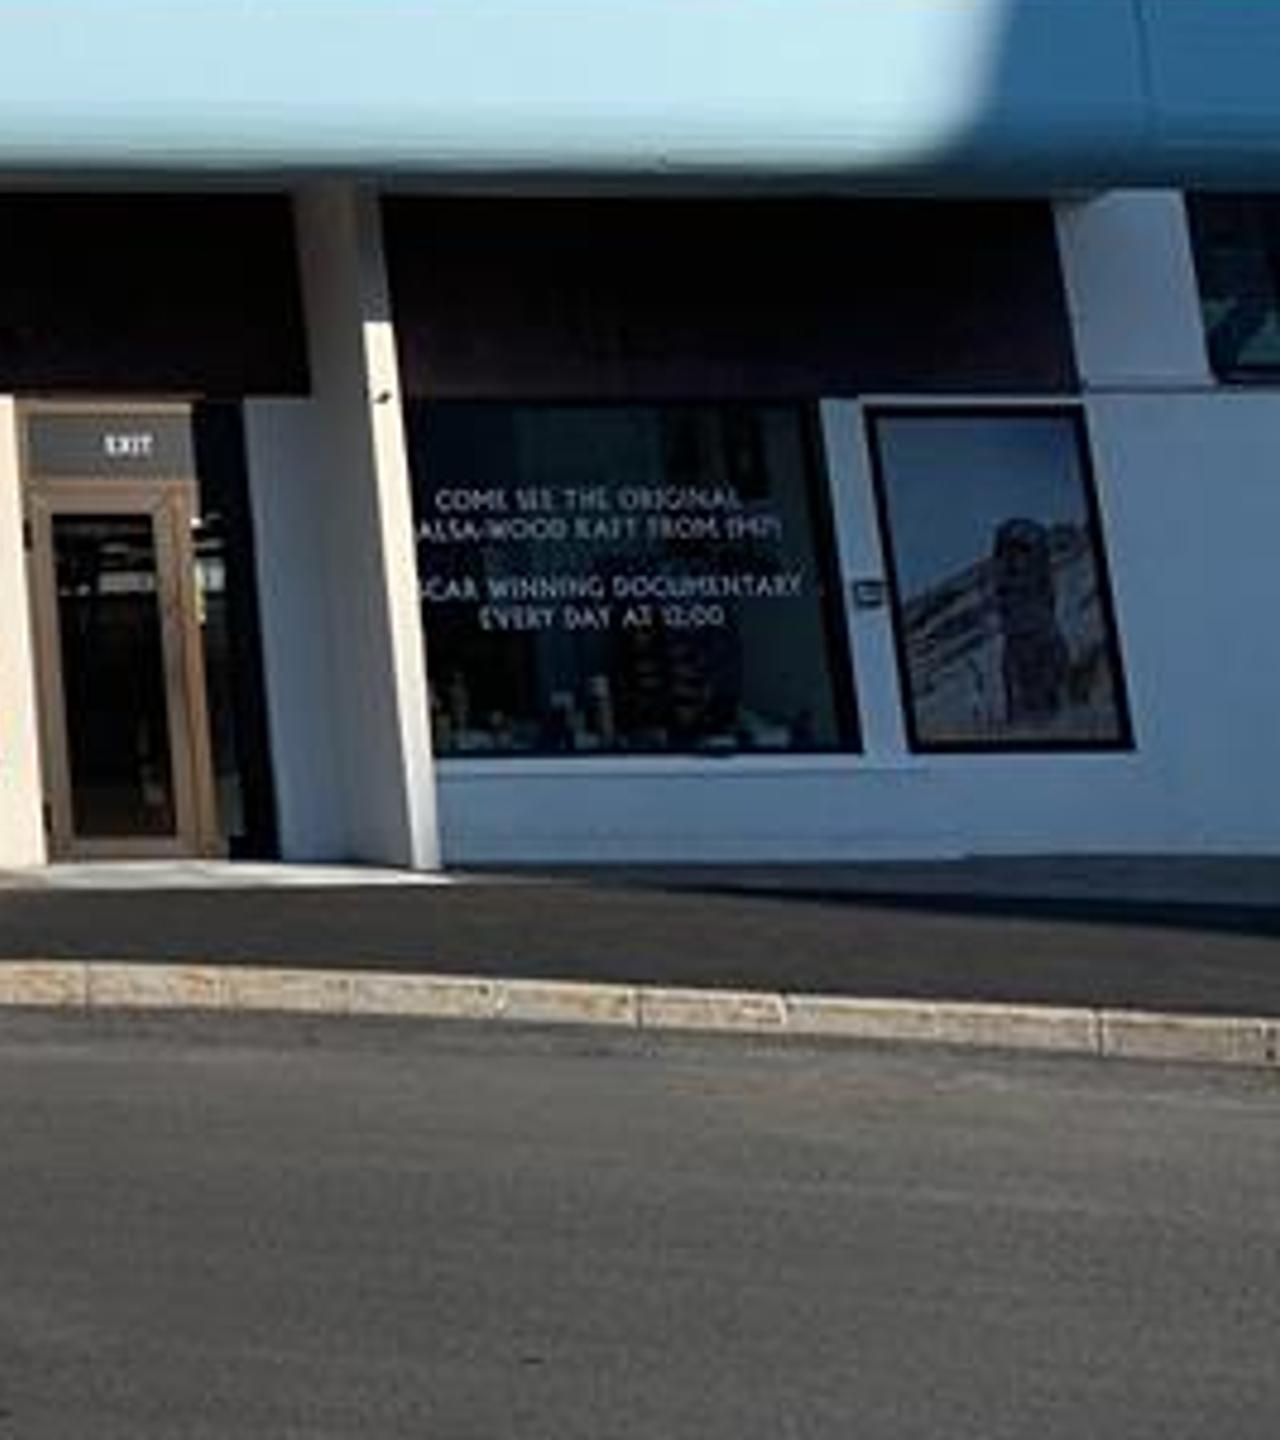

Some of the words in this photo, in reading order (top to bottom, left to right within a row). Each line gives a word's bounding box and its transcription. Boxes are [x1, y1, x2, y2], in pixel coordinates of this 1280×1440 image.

[103, 434, 154, 455] EXIT
[434, 488, 507, 512] COME
[563, 486, 609, 511] THE
[616, 485, 743, 511] ORIGINAL
[645, 514, 721, 540] FROM
[486, 573, 605, 599] WINNING
[611, 571, 801, 598] DOCUMENTARY
[478, 605, 553, 630] EVERY
[564, 605, 610, 630] DAY
[622, 604, 653, 628] AT
